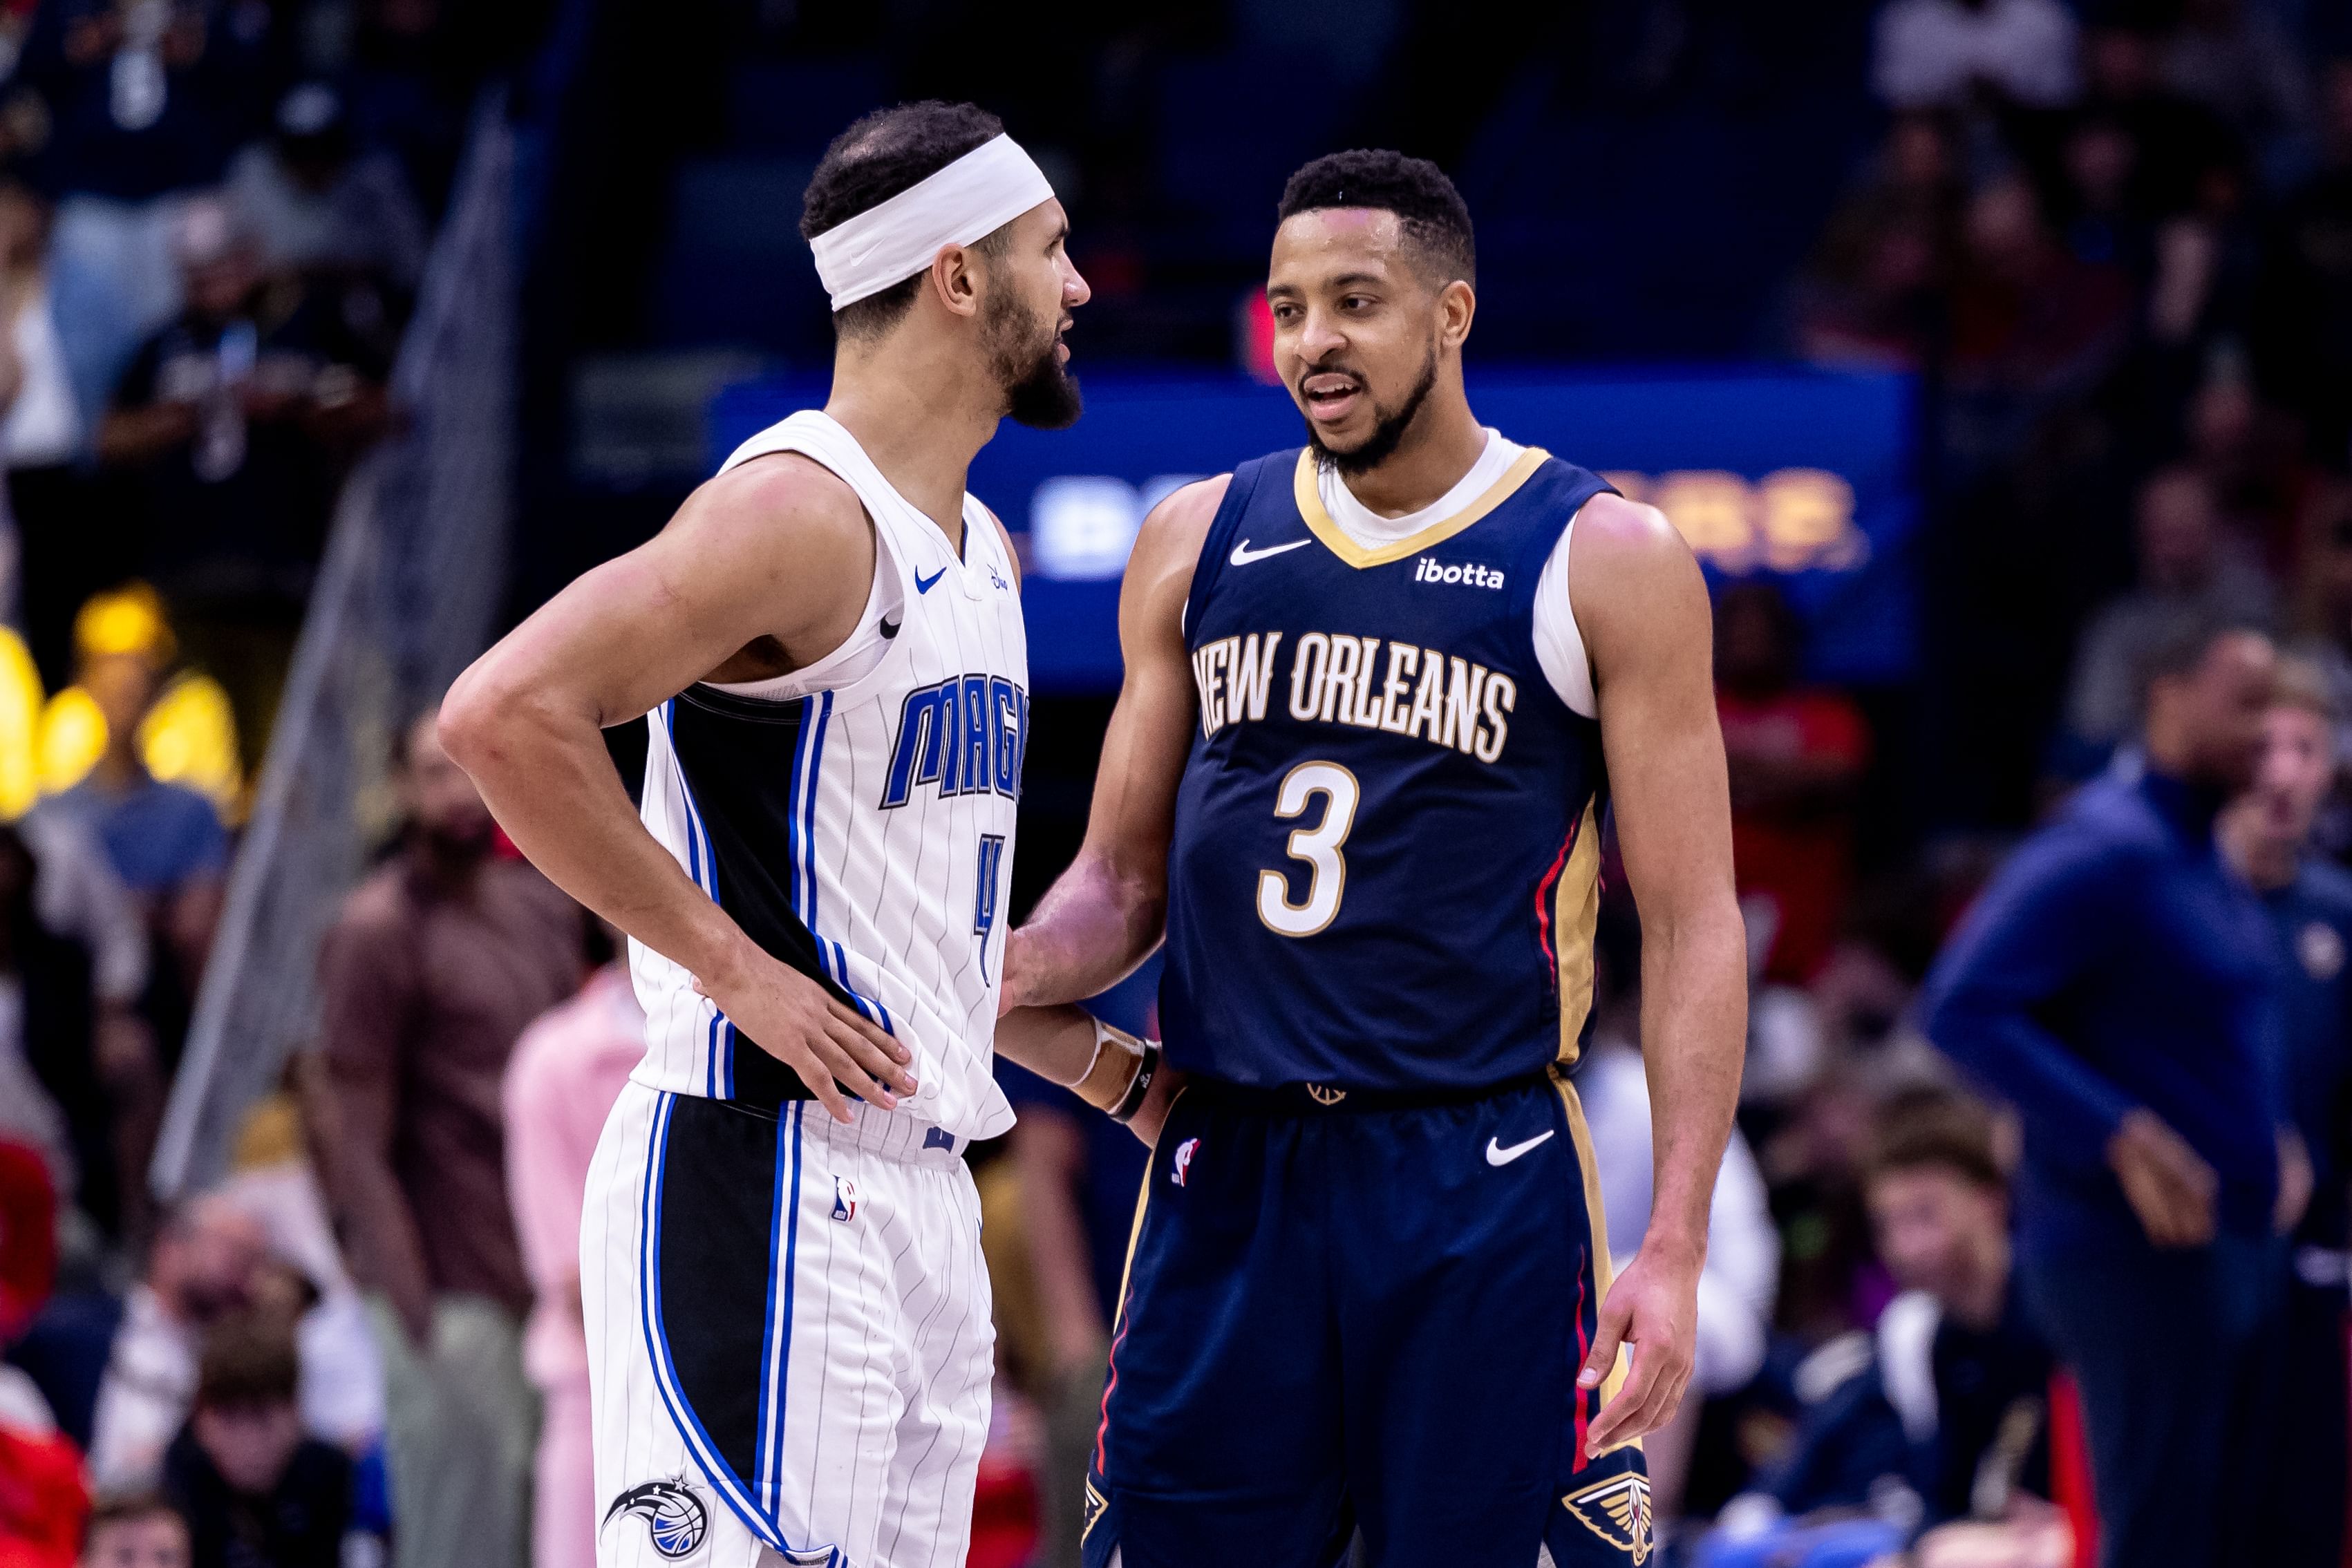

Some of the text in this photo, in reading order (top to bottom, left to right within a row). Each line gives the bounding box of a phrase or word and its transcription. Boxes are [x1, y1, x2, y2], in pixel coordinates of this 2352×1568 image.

[1415, 557, 1505, 589] ibotta
[1192, 632, 1516, 763] NEW ORLEANS
[973, 833, 1006, 988] 4
[1257, 760, 1360, 938] 3
